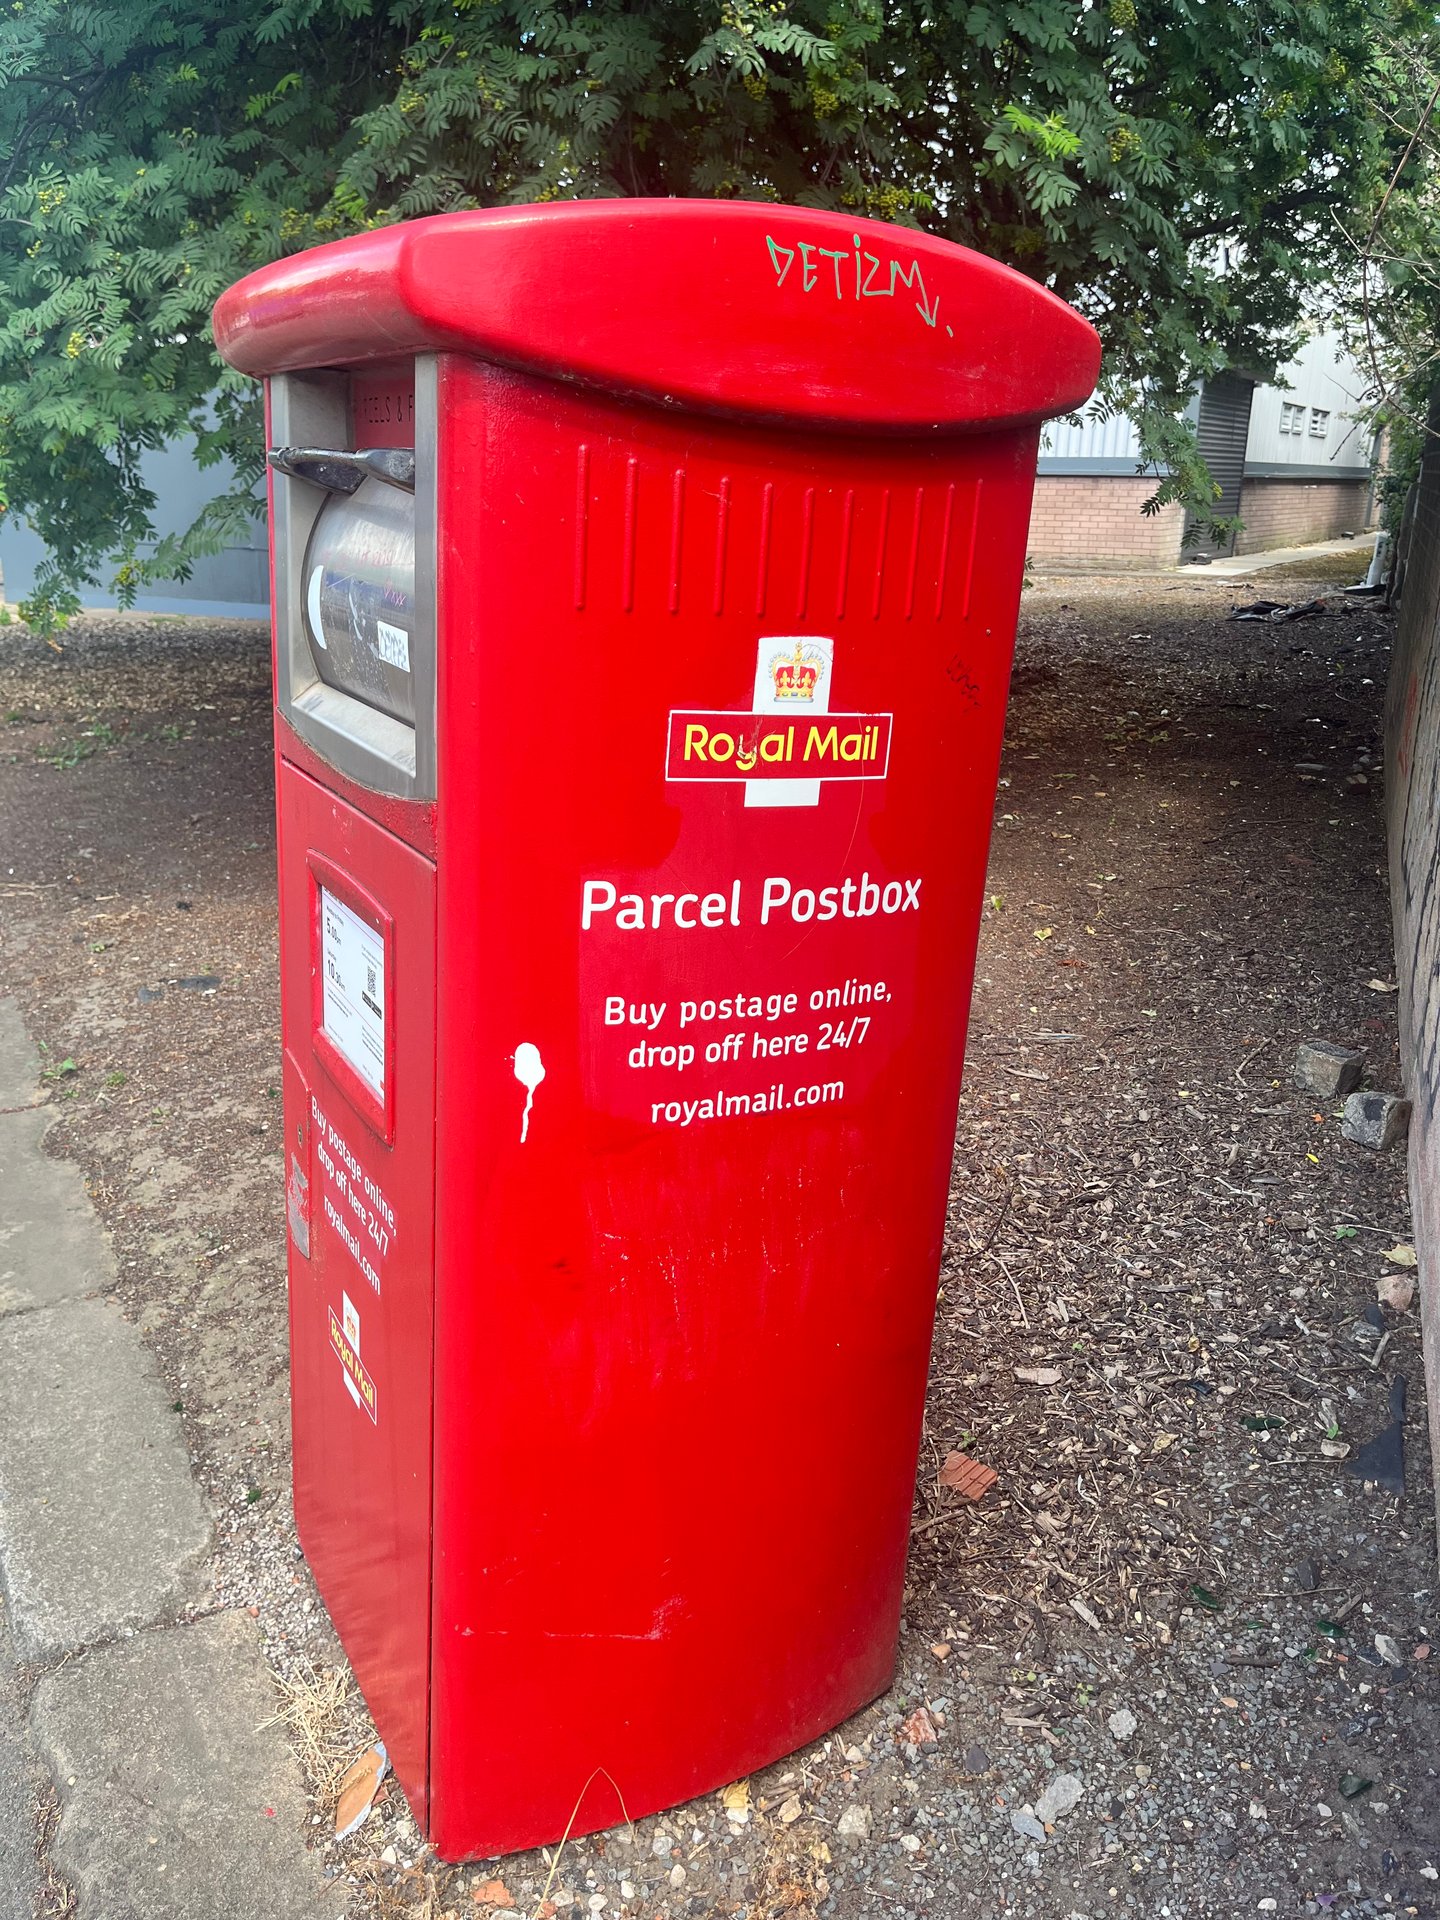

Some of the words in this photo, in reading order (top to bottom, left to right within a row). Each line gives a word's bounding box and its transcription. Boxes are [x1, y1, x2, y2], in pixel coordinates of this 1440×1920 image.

[683, 724, 795, 771] Royal
[802, 725, 879, 762] Mail
[581, 879, 741, 930] Parcel
[760, 871, 922, 925] Postbox
[603, 996, 667, 1030] Buy
[679, 993, 798, 1028] postage
[809, 978, 892, 1010] online,
[628, 1040, 695, 1071] drop
[704, 1032, 746, 1063] off
[751, 1031, 809, 1059] here
[816, 1016, 871, 1050] 24/7
[651, 1080, 845, 1127] royalmail.com
[311, 1095, 327, 1136] Buy
[328, 1124, 362, 1183] postage
[364, 1176, 397, 1237] online,
[317, 1141, 335, 1180] drop
[335, 1169, 347, 1196] off
[348, 1183, 366, 1226] here
[368, 1212, 389, 1257] 24/7
[324, 1195, 381, 1296] royalmail.com
[331, 1316, 354, 1373] Royal
[354, 1360, 374, 1409] Mail
